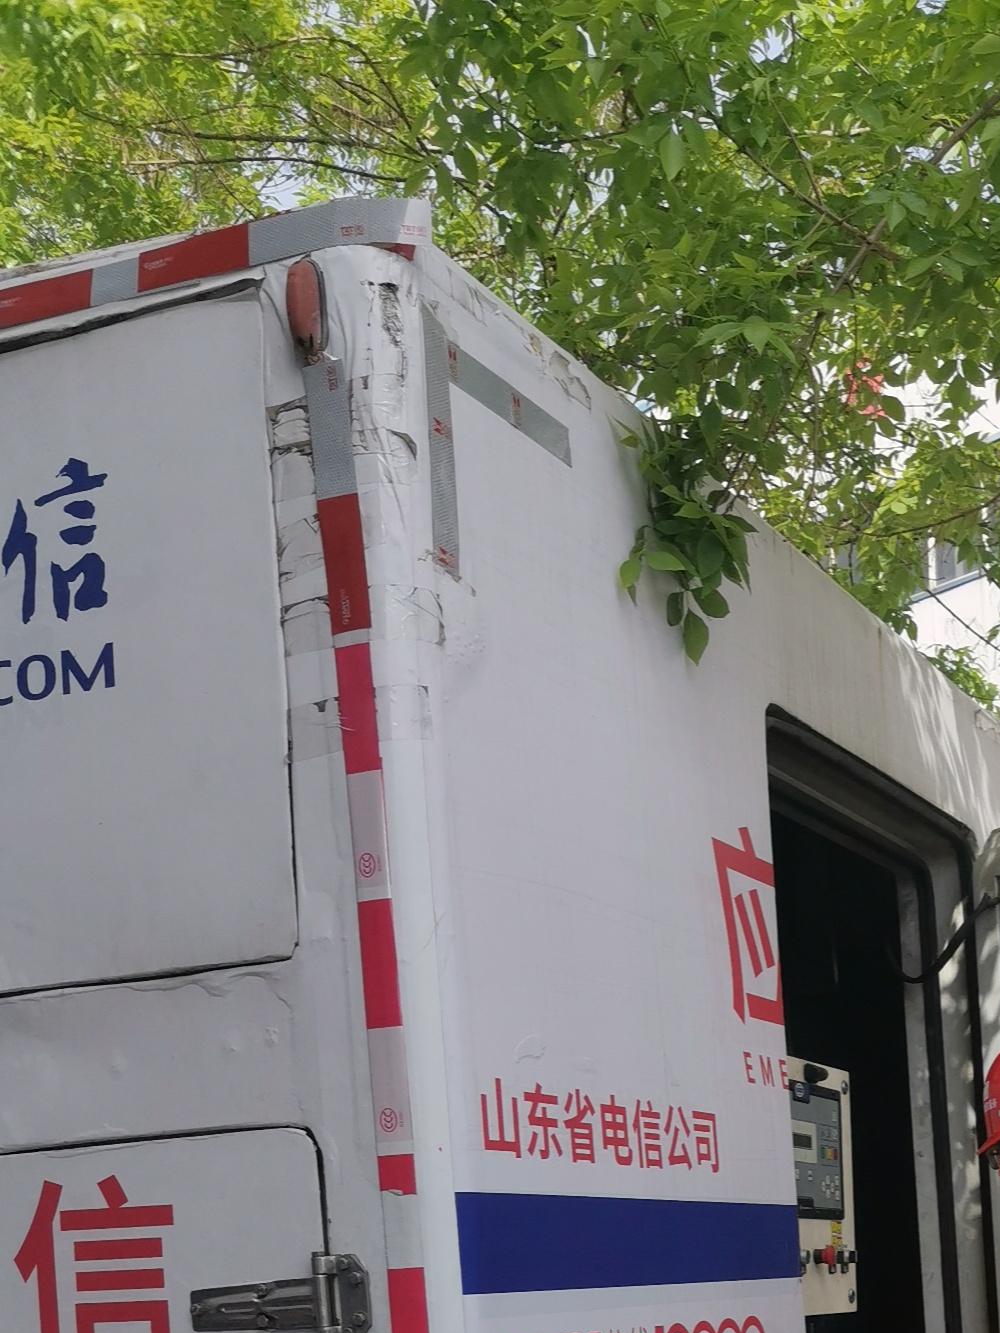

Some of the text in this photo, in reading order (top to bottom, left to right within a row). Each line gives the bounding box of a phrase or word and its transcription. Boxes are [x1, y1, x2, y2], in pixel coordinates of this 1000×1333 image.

[2, 457, 108, 625] 信
[743, 1051, 789, 1091] EME
[480, 1078, 719, 1173] 山东省电信公司
